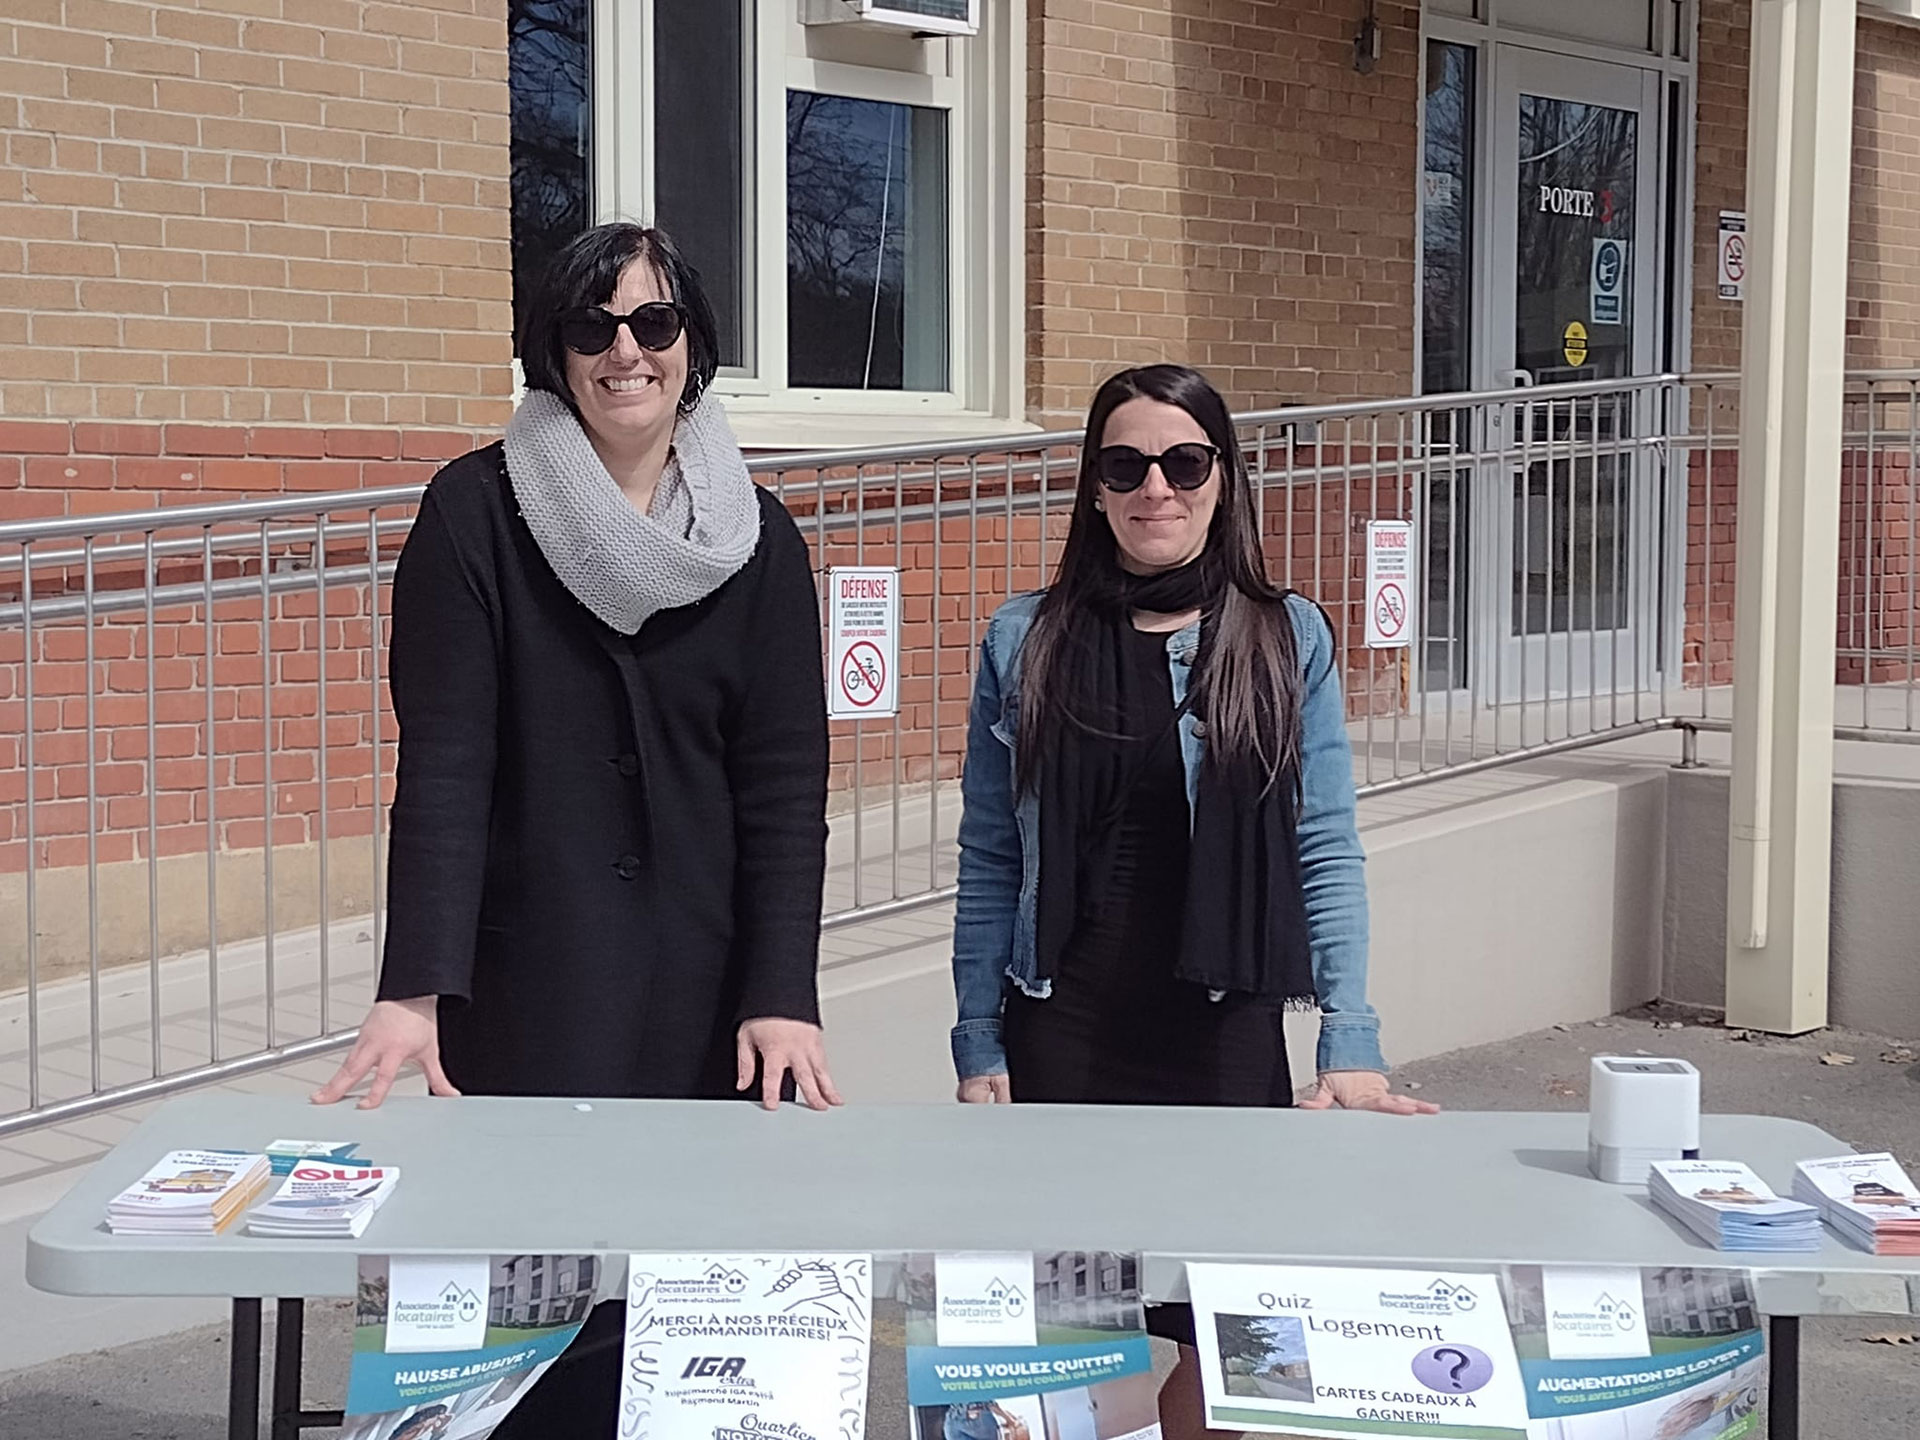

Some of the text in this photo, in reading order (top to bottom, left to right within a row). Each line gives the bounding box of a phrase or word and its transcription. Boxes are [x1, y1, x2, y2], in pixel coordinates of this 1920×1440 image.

[1539, 186, 1614, 223] PORTE 3
[841, 575, 888, 599] DÉFENSE
[655, 1283, 720, 1294] locataires
[395, 1301, 440, 1310] Association
[1257, 1292, 1313, 1310] Quiz
[1380, 1298, 1451, 1310] locataires
[394, 1311, 455, 1322] locataires
[943, 1306, 1001, 1317] locataires
[650, 1313, 848, 1331] MERCI À NOS PRÉCIEUX
[1308, 1314, 1444, 1342] Logement
[1553, 1320, 1612, 1331] locataires
[665, 1326, 831, 1341] COMMANDITAIRES!
[394, 1367, 460, 1386] HAUSSE
[460, 1352, 526, 1377] ABUSIVE
[526, 1349, 537, 1359] ?
[680, 1356, 747, 1379] IGA
[934, 1352, 1125, 1379] VOUS VOULEZ QUITTER
[1537, 1369, 1663, 1392] AUGMENTATION
[1664, 1366, 1687, 1379] DE
[1687, 1349, 1740, 1372] LOYER
[719, 1376, 755, 1387] extra
[941, 1379, 978, 1391] VOTRE
[979, 1378, 1016, 1390] LOYER
[1017, 1377, 1033, 1387] EN
[1034, 1374, 1072, 1385] COURS
[1073, 1372, 1088, 1380] DE
[728, 1398, 760, 1407] Martin
[1316, 1385, 1477, 1408] CARTES CADEAUX À
[1554, 1394, 1586, 1405] VOUS
[1616, 1389, 1631, 1397] LE
[1356, 1407, 1441, 1424] GAGNER!!!
